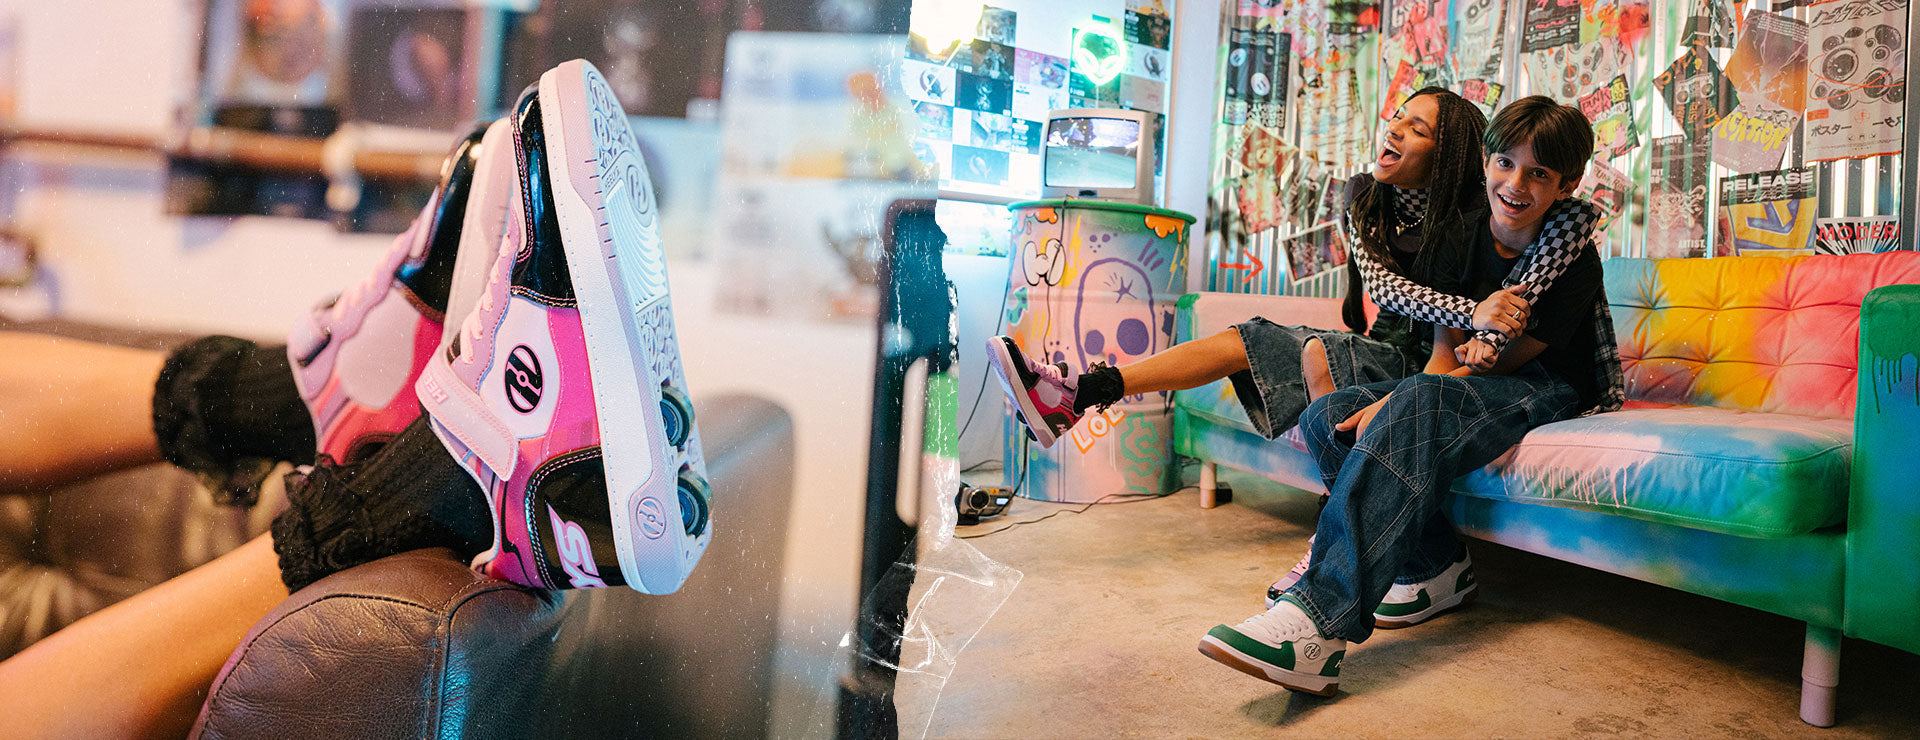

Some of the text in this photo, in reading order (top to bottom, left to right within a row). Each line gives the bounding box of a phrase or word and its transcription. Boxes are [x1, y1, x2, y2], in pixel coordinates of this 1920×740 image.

[1722, 171, 1813, 193] RELEASE
[1818, 223, 1900, 241] MODER
[1071, 404, 1126, 455] LOL
